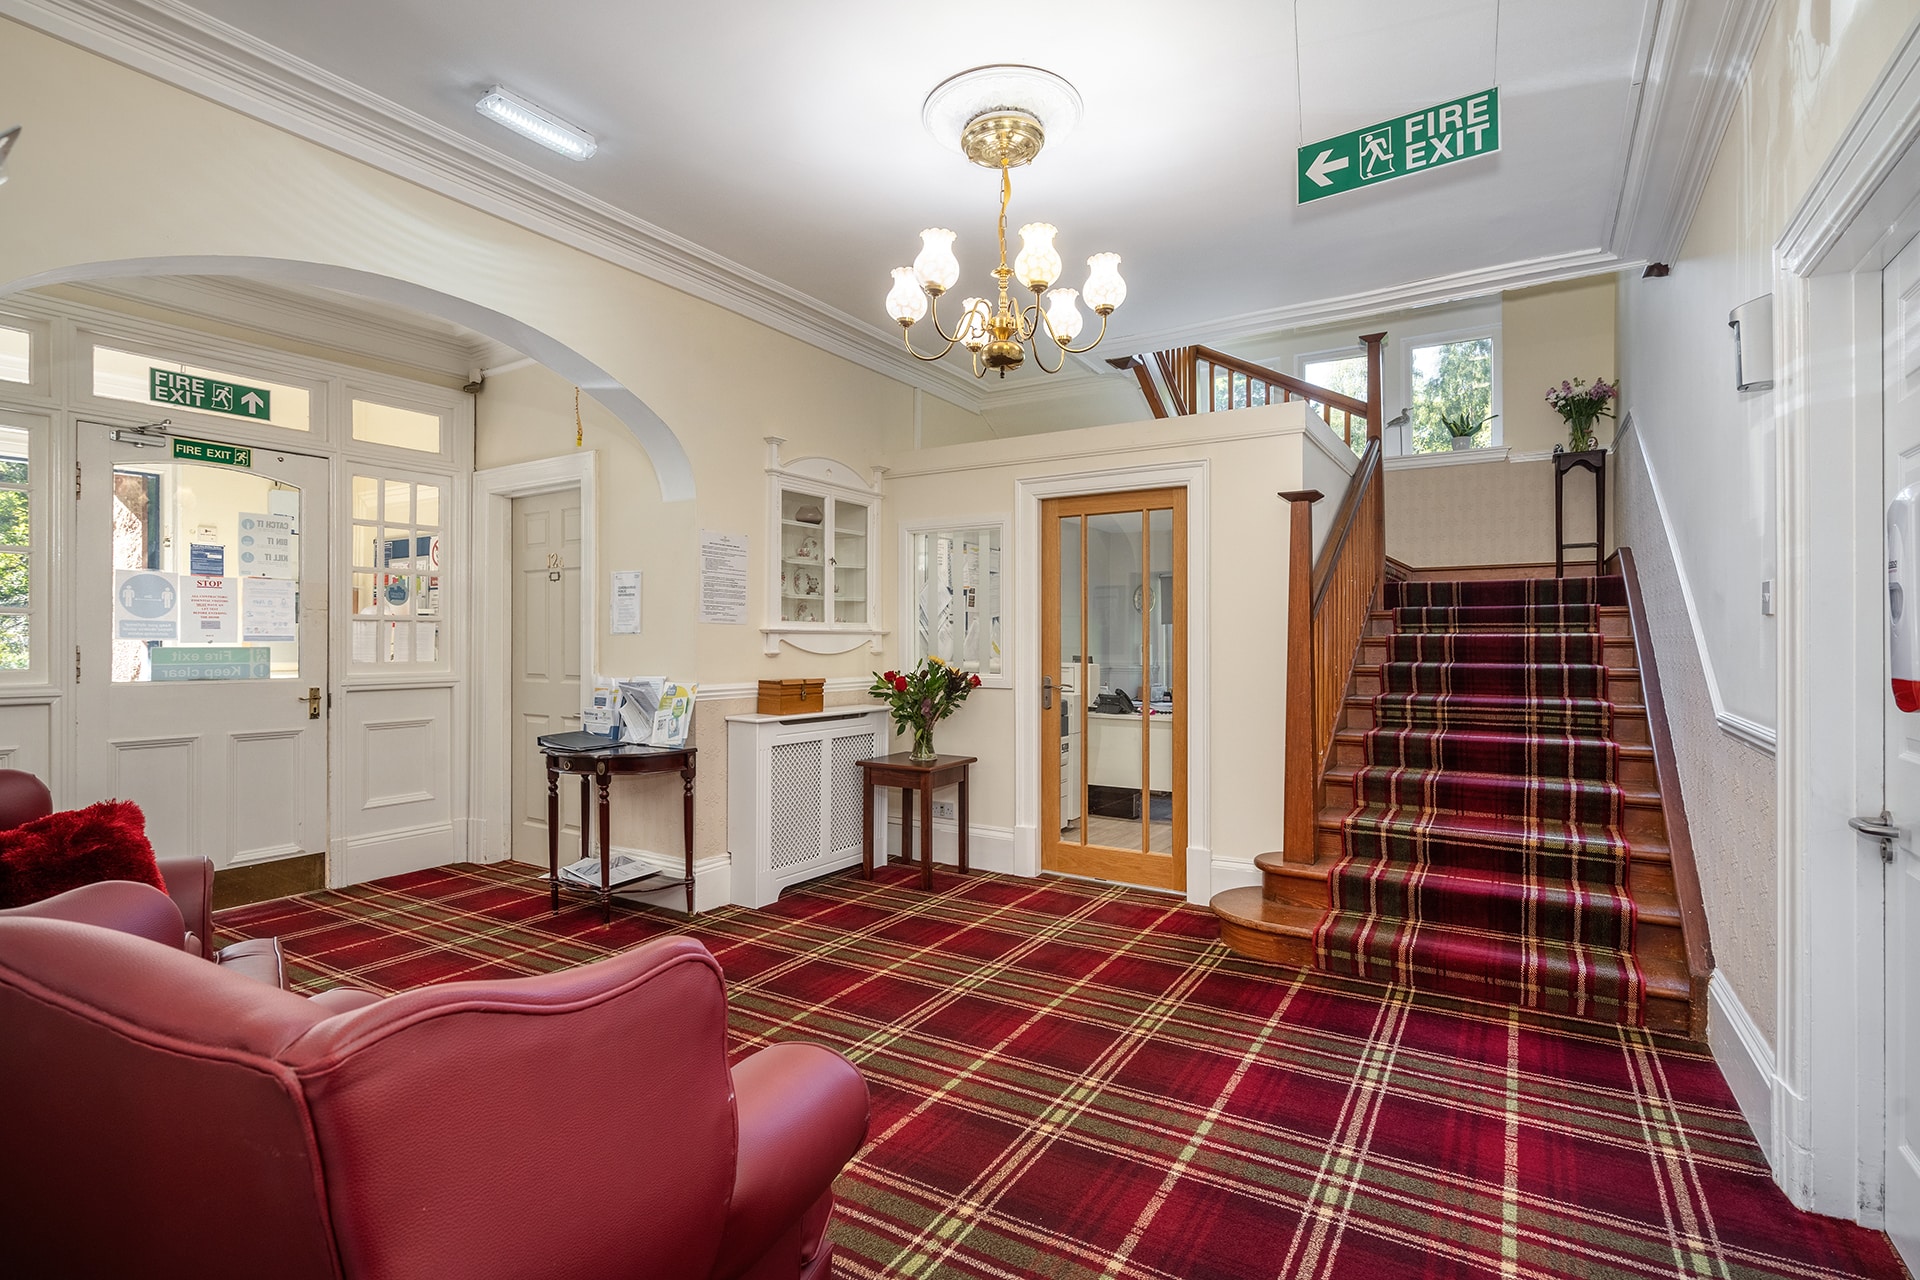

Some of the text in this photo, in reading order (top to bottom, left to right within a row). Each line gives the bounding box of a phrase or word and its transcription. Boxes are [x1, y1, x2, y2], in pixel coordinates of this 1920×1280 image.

[1405, 94, 1489, 144] FIRE
[1405, 122, 1490, 170] EXIT
[155, 371, 205, 393] FIRE
[155, 385, 205, 406] EXIT
[176, 444, 231, 460] FIRE EXIT
[197, 580, 222, 589] STOP
